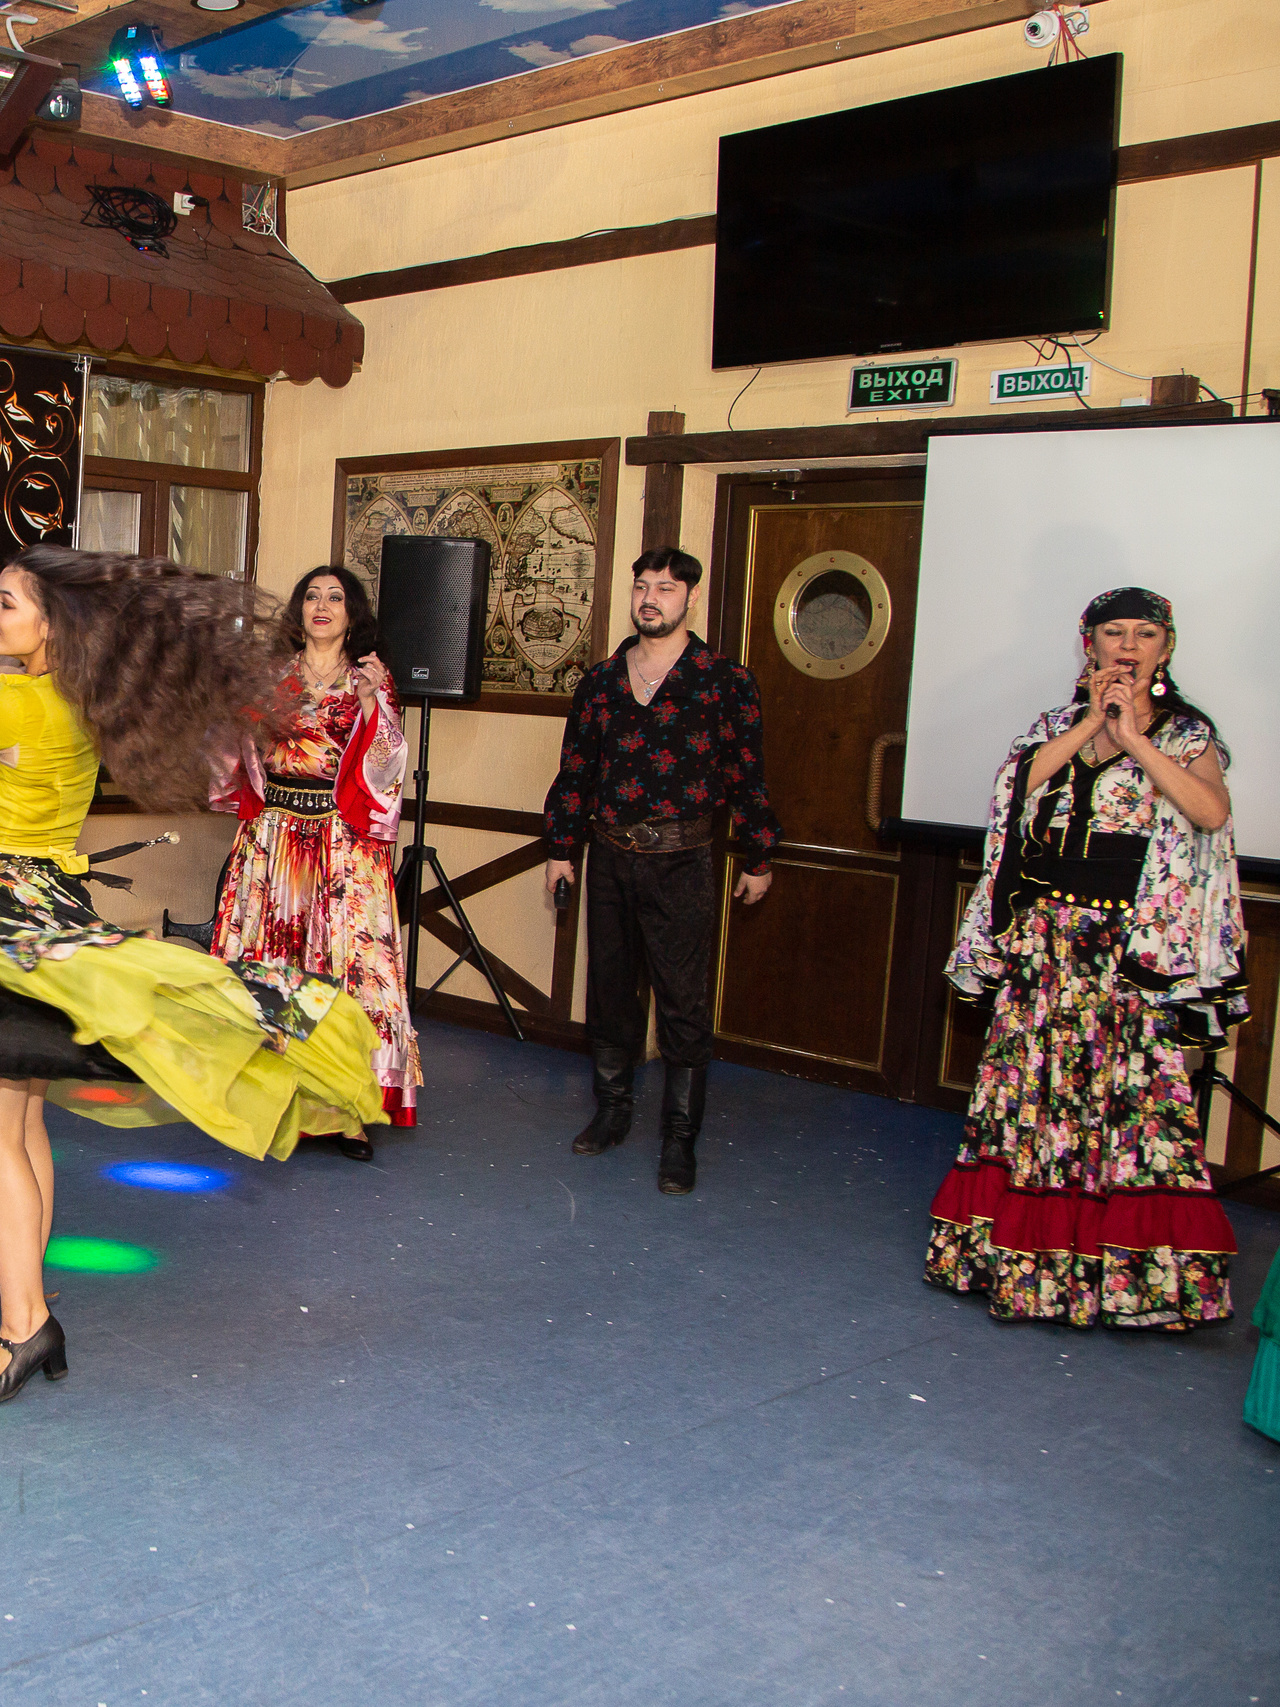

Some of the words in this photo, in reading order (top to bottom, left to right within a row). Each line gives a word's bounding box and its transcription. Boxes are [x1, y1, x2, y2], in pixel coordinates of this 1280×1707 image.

[858, 368, 943, 389] ВЫХОД
[1002, 369, 1081, 393] ВЫХОД
[870, 387, 930, 402] EXIT
